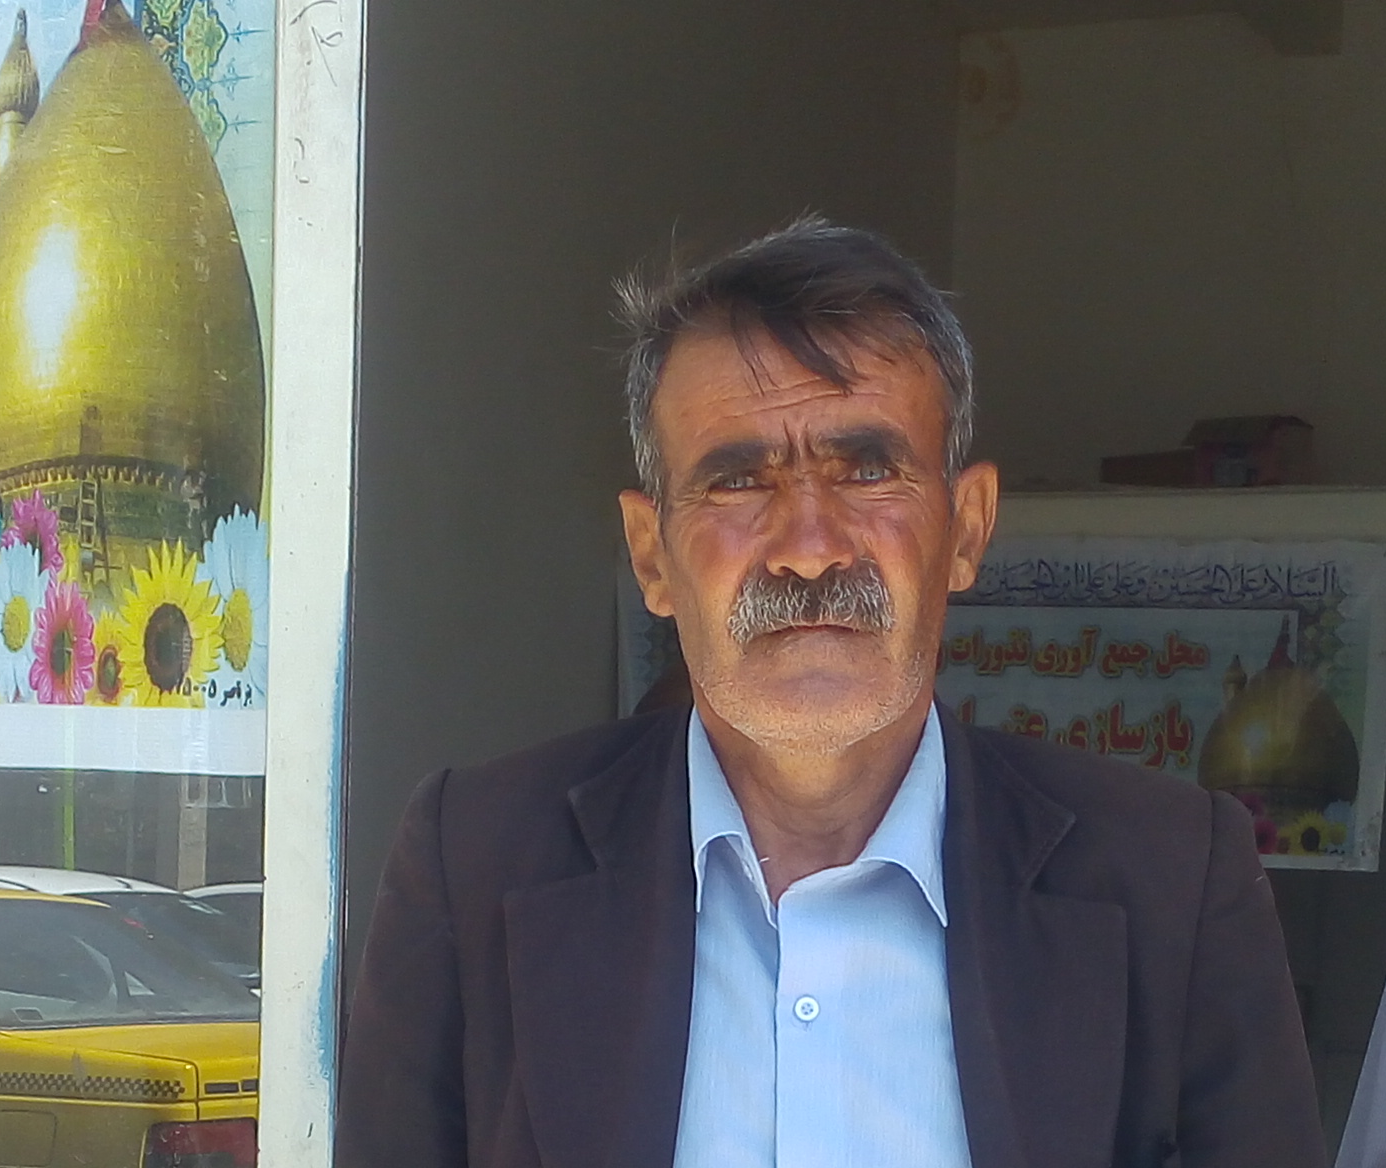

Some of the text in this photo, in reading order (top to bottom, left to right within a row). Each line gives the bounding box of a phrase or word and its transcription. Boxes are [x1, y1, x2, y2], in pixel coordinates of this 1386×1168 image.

[1031, 625, 1101, 677] آوری
[1098, 639, 1153, 677] جمع
[1154, 629, 1210, 677] محل
